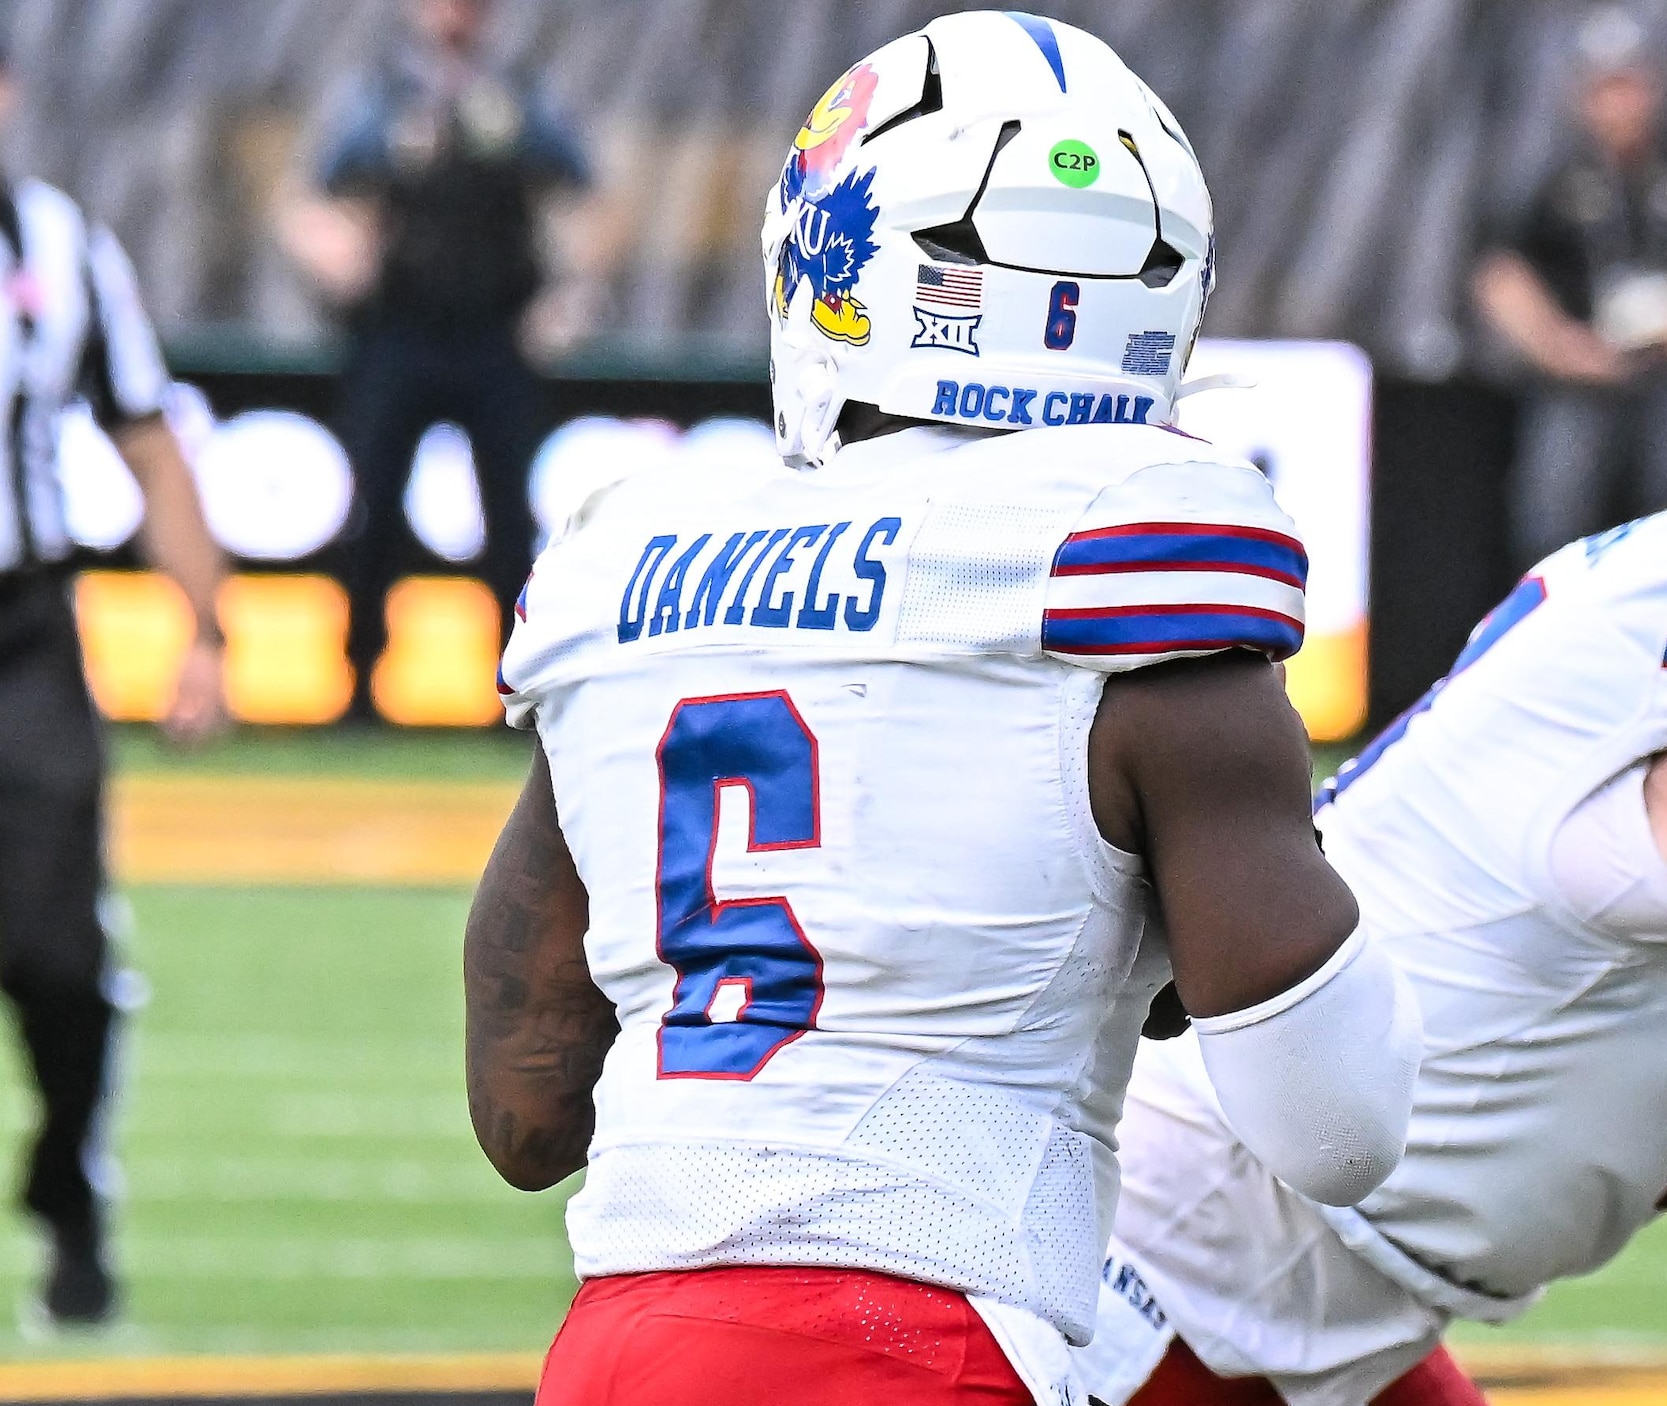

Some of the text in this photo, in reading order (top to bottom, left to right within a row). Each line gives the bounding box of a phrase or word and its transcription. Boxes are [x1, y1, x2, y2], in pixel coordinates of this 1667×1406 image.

[1053, 152, 1096, 173] C2P
[1044, 281, 1080, 350] 6
[931, 380, 1155, 426] ROCK CHALK
[617, 517, 902, 643] DANIELS
[655, 688, 825, 1081] 6
